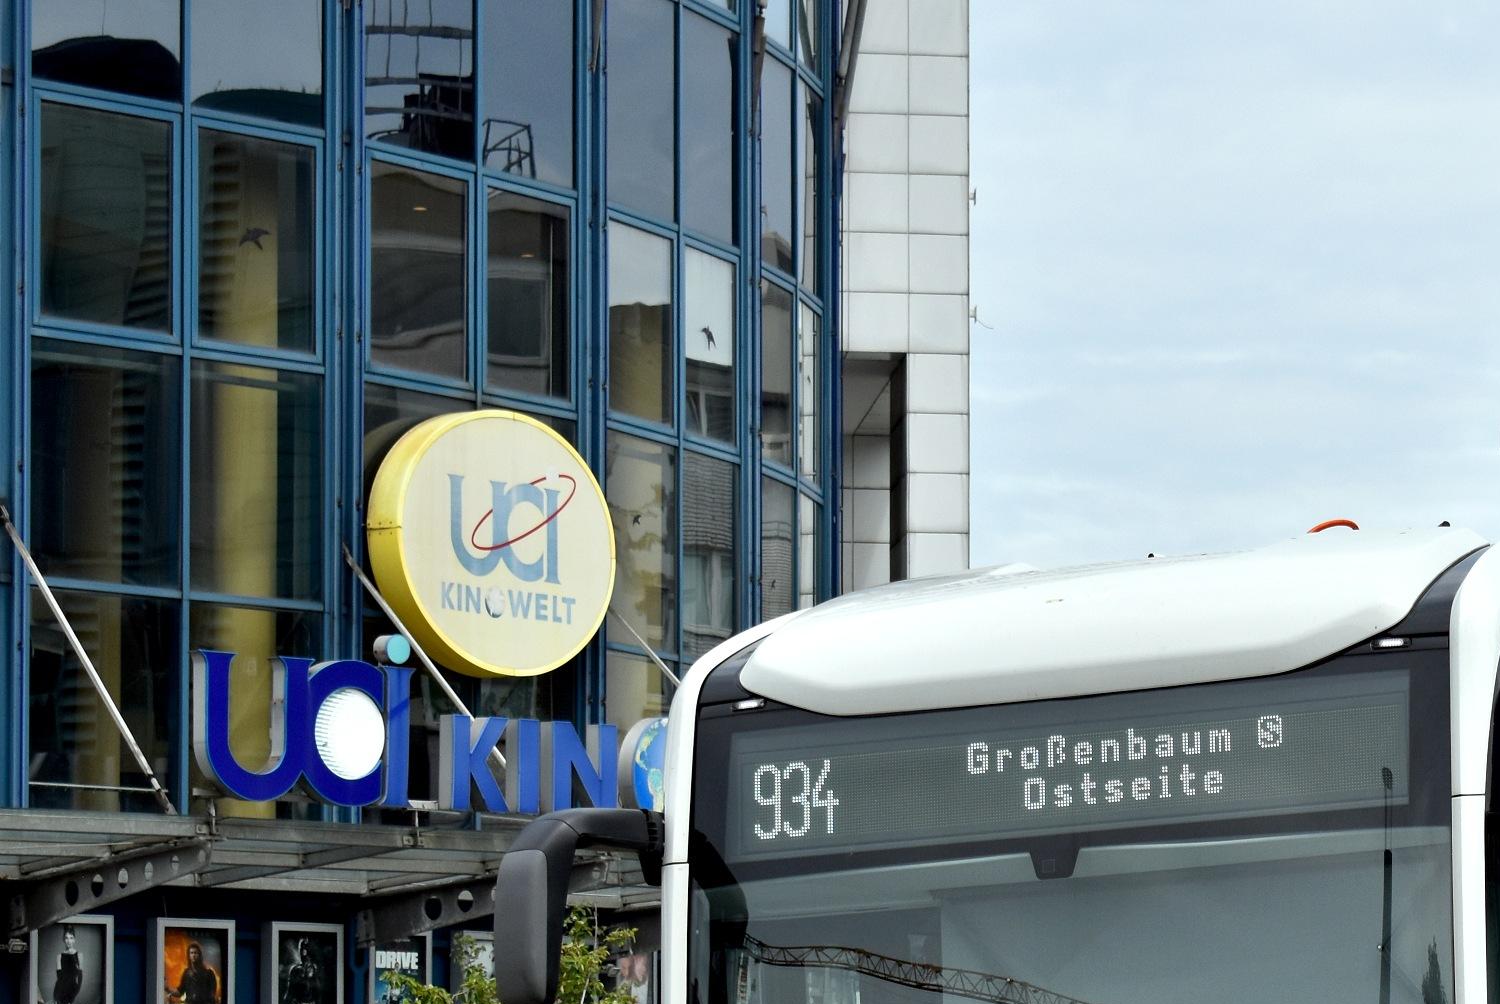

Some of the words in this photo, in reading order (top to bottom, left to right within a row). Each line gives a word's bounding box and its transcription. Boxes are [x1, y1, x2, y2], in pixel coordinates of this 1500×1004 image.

[966, 725, 1232, 776] Großenbaum
[753, 758, 840, 841] 934
[1023, 763, 1224, 811] Ostseite
[375, 950, 419, 970] DRIVE
